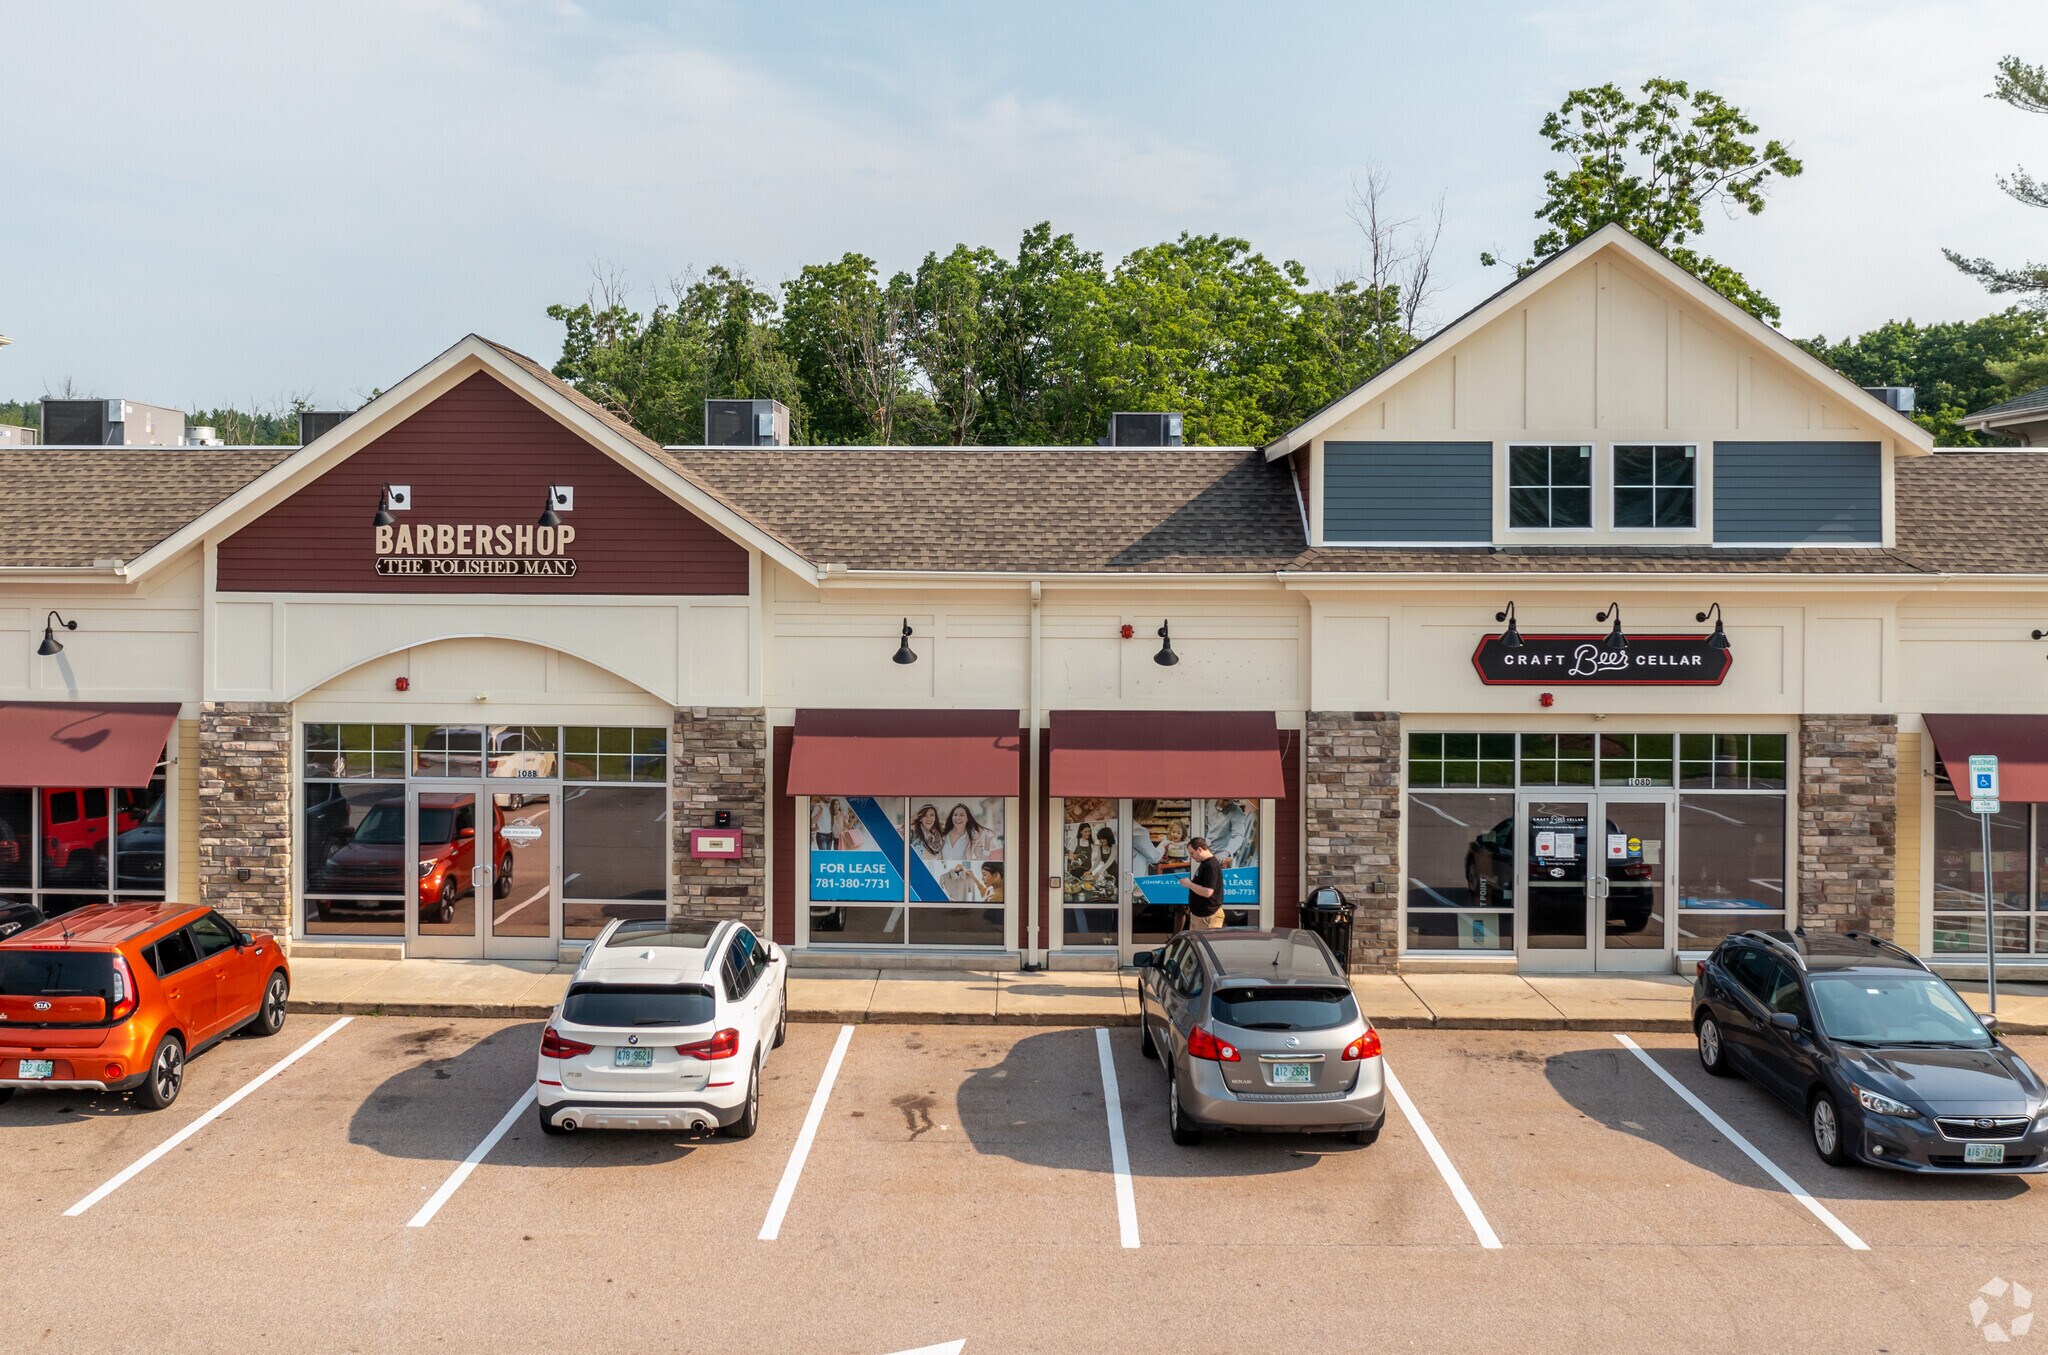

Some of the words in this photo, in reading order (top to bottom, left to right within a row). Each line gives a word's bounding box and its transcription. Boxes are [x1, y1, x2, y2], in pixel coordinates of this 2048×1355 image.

[375, 524, 576, 556] BARBERSHOP
[384, 559, 423, 574] THE
[430, 559, 519, 575] POLISHED
[524, 560, 568, 575] MAN
[1504, 654, 1565, 666] CRAFT
[1568, 643, 1629, 676] Beer
[1636, 654, 1702, 666] CELLAR
[820, 863, 845, 874] FOR
[848, 863, 886, 874] LEASE
[815, 878, 890, 889] 781-380-7731
[1223, 888, 1256, 896] 380-7731
[617, 1050, 630, 1060] 478
[21, 1063, 33, 1073] 332
[1275, 1067, 1288, 1076] 412
[1967, 1147, 1980, 1157] 416
[1985, 1148, 2002, 1158] 1214
